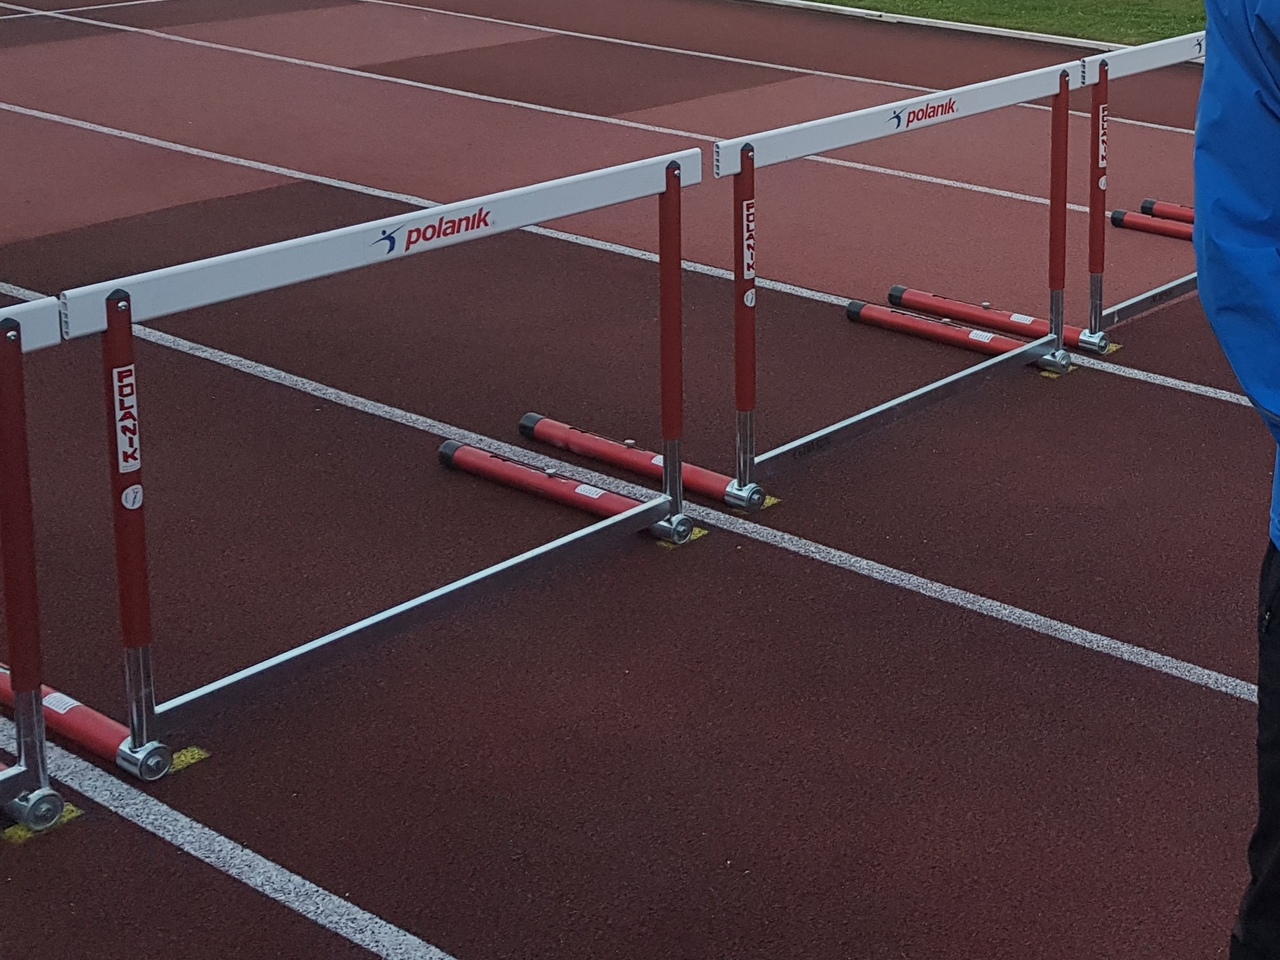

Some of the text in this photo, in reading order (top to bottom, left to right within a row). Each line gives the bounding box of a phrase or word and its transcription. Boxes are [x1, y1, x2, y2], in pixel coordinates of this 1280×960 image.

[905, 97, 956, 128] polanik
[404, 206, 491, 253] polanik
[117, 368, 139, 463] POLANIK
